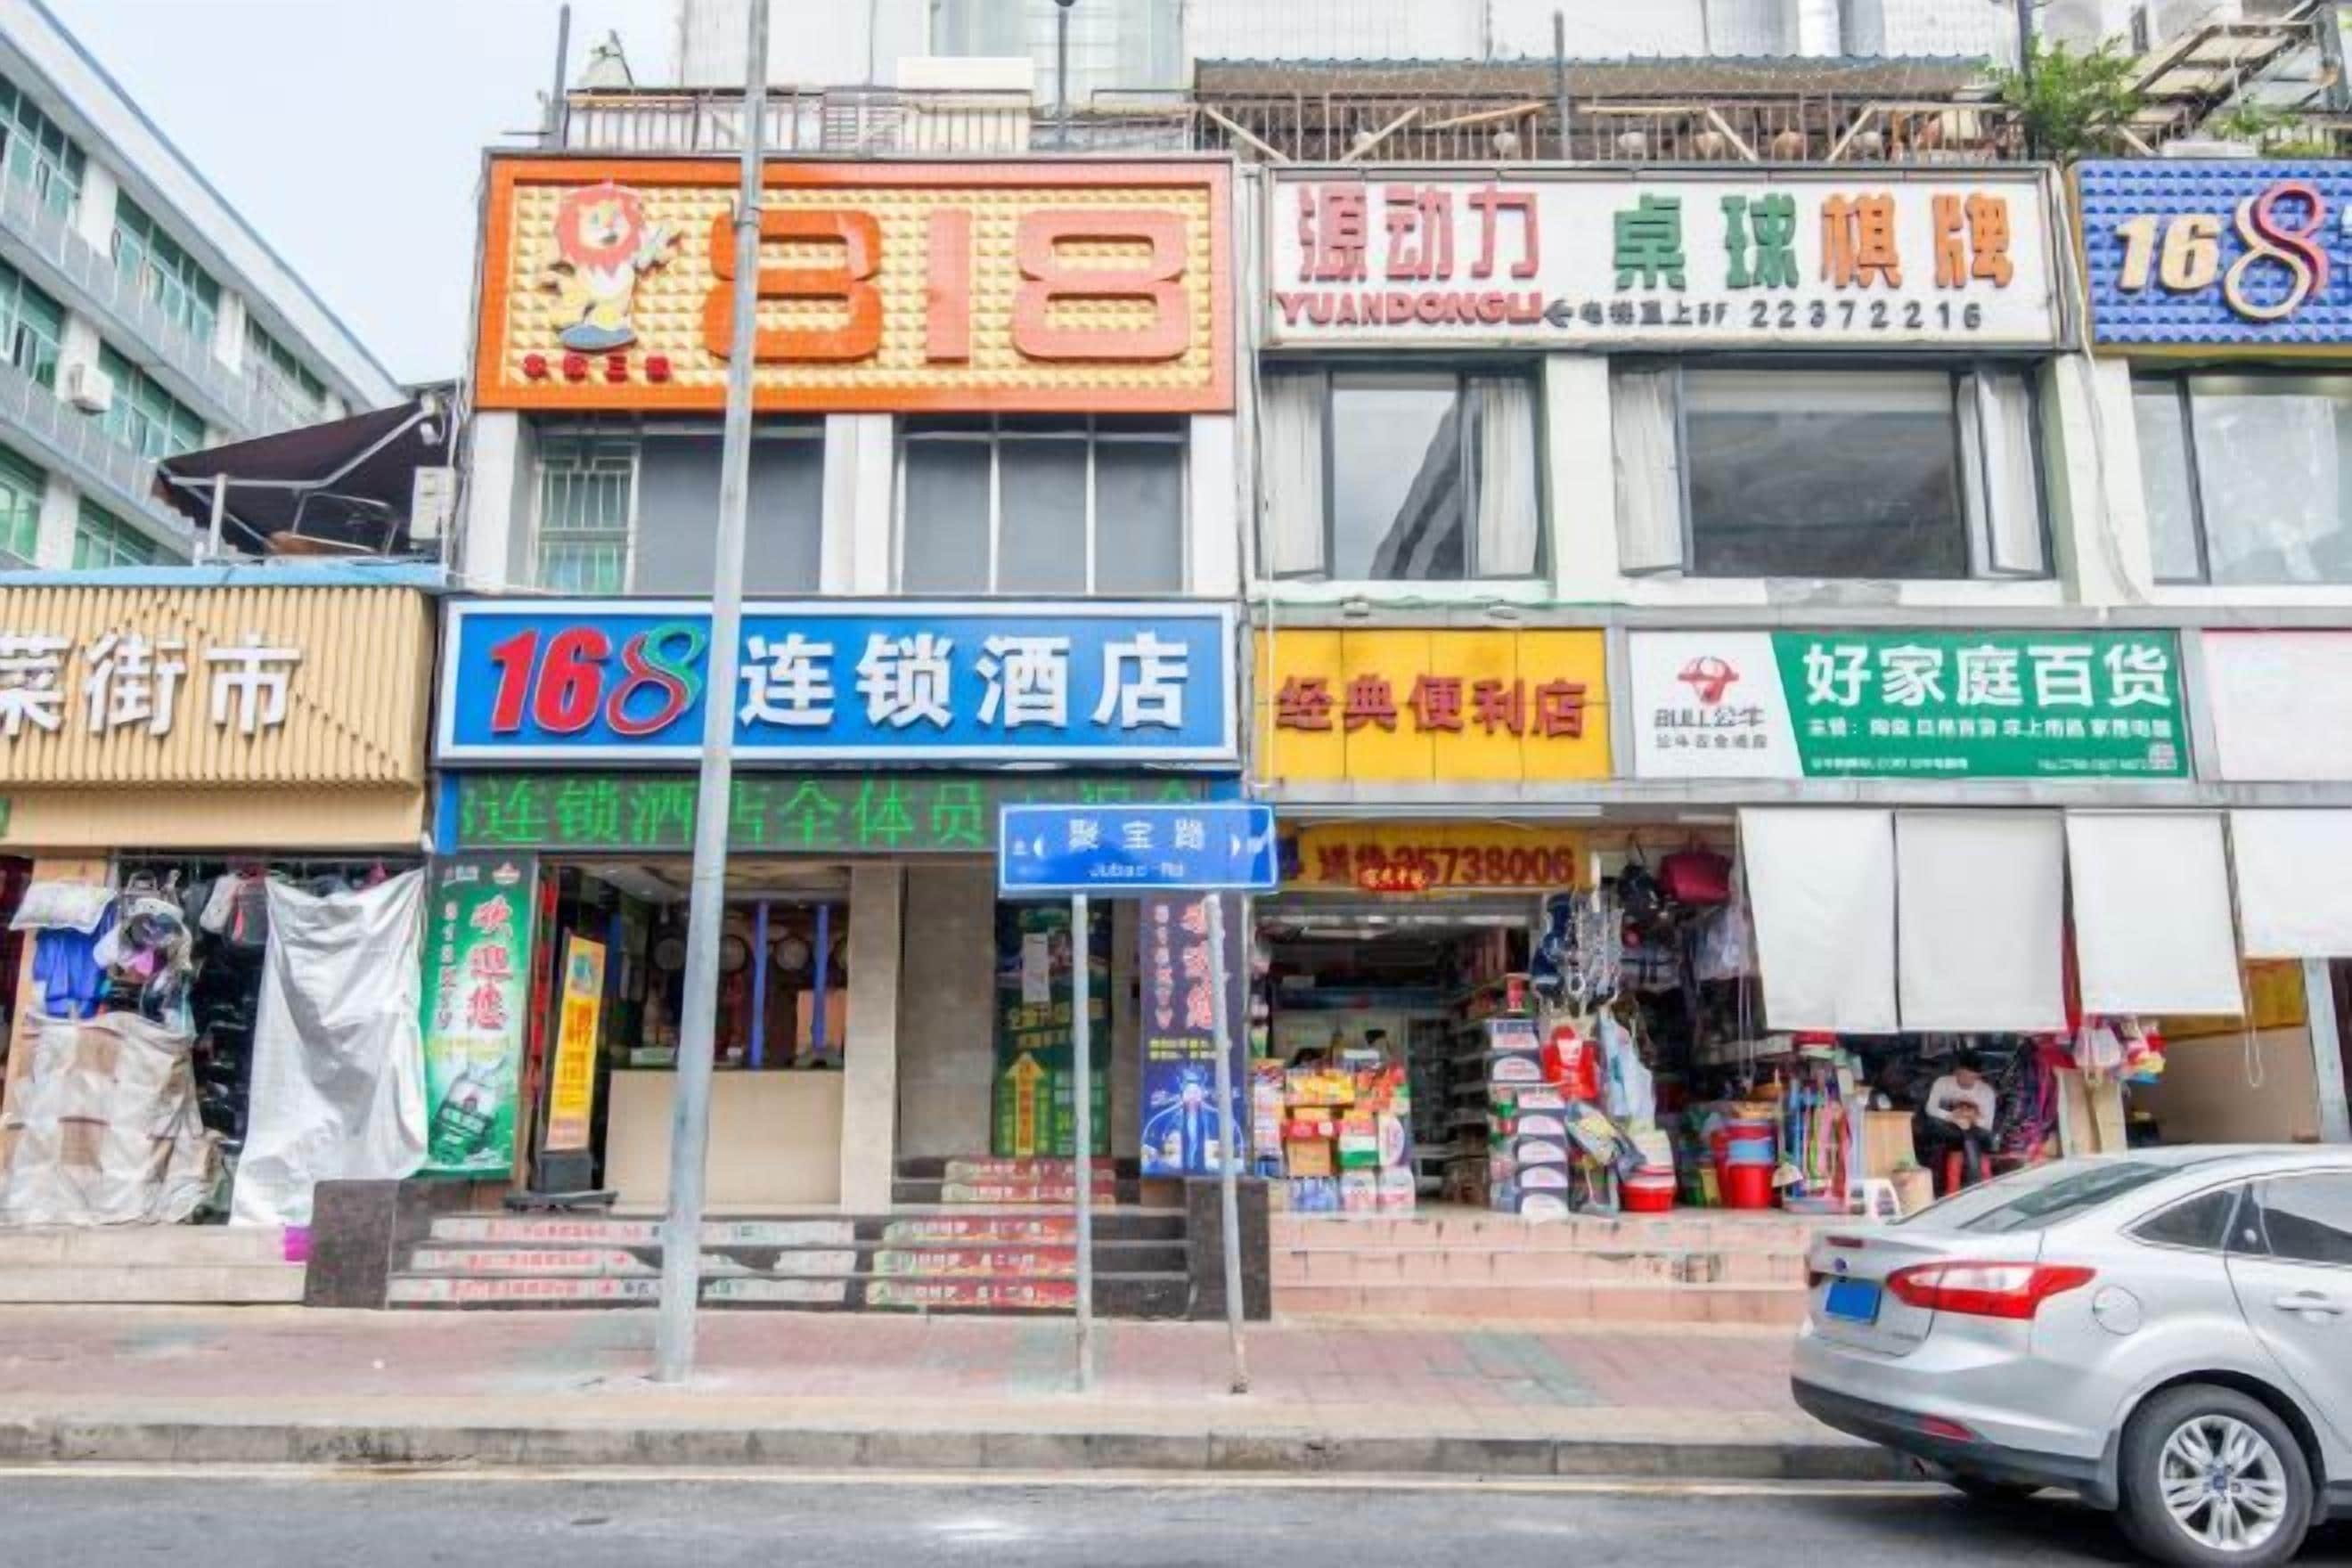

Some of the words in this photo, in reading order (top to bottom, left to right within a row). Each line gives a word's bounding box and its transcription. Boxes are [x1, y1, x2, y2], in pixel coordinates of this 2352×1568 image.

[1297, 184, 1539, 282] 源动力
[1613, 192, 2013, 290] 桌球棋牌
[2114, 181, 2328, 323] 168
[703, 208, 1190, 363] 818
[1275, 292, 1543, 325] YUANDONGLI
[1750, 299, 1983, 330] 22372216
[491, 623, 706, 737] 168
[739, 631, 1190, 731] 连锁酒店
[1276, 674, 1586, 738] 经典便利店
[1802, 643, 2173, 709] 好家庭百货
[1068, 819, 1205, 851] 聚宝路
